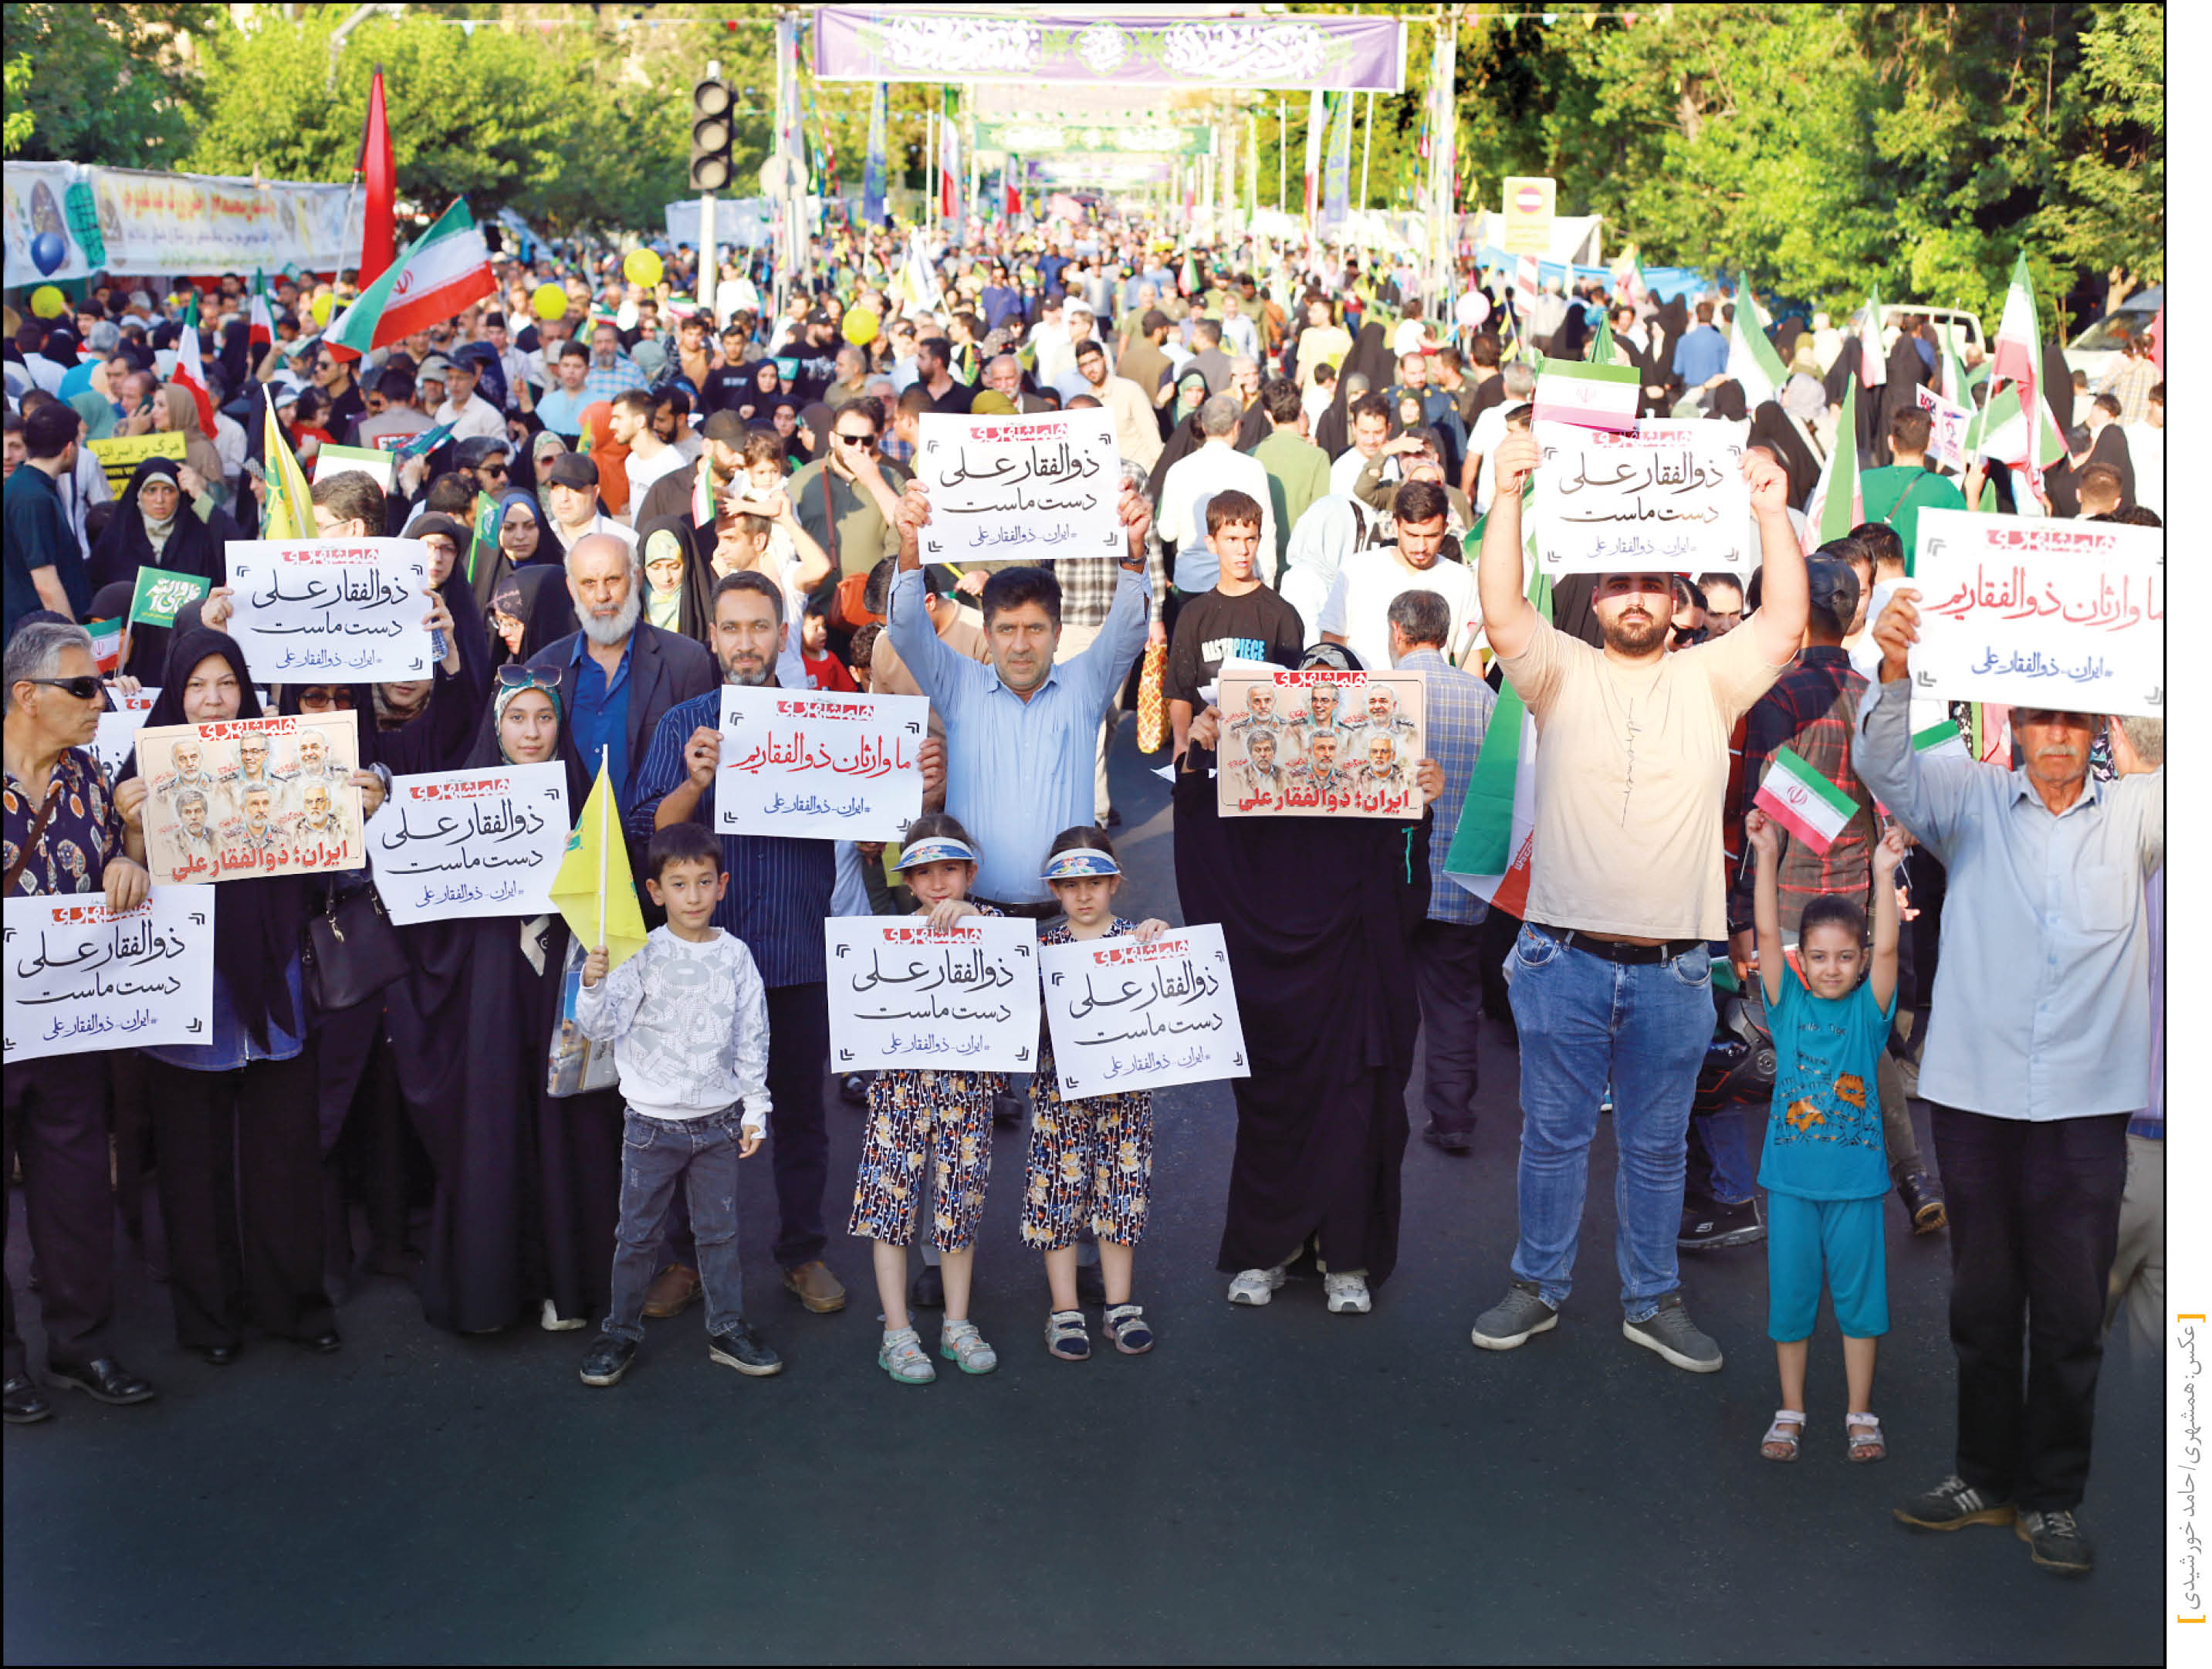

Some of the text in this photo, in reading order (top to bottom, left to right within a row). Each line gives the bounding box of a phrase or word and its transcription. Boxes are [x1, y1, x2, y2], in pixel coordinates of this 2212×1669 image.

[969, 422, 1067, 442] همشهری
[139, 445, 148, 457] بر
[153, 438, 179, 455] مرگ
[940, 443, 1099, 487] ذوالفقار علی
[1559, 451, 1723, 494] ذوالفقار علی
[942, 488, 1097, 513] دست ماست
[1559, 496, 1719, 523] دست ماست
[281, 549, 380, 564] همشهری
[252, 568, 408, 610] ذوالفقار علی
[1922, 563, 2061, 621] ذوالفقاریم
[2063, 572, 2141, 632] وارثان
[251, 612, 402, 637] دست ماست
[1273, 672, 1368, 688] همشهری
[776, 700, 874, 721] همشهری
[198, 718, 297, 742] همشهری
[727, 730, 911, 778] ما وارثان ذوالفقاریم
[409, 778, 512, 802] همشهری
[1239, 787, 1409, 814] ایران؛ ذوالفقار علی
[382, 798, 543, 849] ذوالفقار علی
[172, 840, 348, 882] ایران؛ ذوالفقار علی
[384, 847, 543, 874] دست ماست
[17, 919, 185, 978] ذوالفقار علی
[883, 928, 982, 944] همشهری
[1093, 940, 1191, 967] همشهری
[852, 946, 1014, 993] ذوالفقار علی
[15, 972, 181, 1004] دست ماست
[1068, 962, 1219, 1019] ذوالفقار علی
[853, 995, 1011, 1022] دست ماست
[1073, 1013, 1223, 1045] دست ماست
